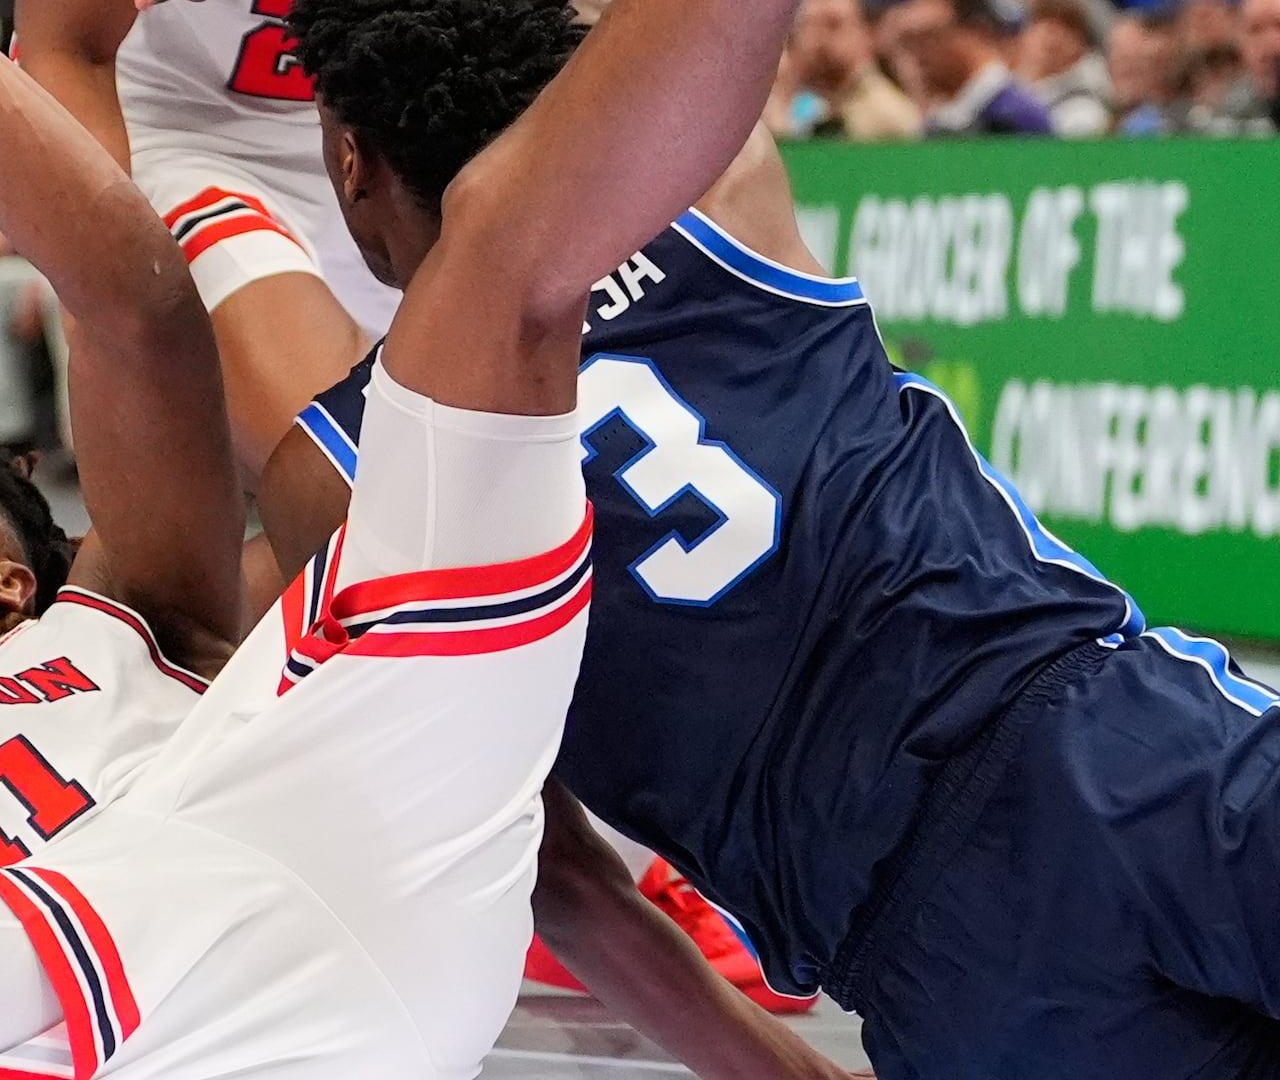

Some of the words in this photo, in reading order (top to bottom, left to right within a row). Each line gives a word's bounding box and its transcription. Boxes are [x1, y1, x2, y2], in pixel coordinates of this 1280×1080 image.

[849, 192, 1015, 324] GROCER
[1017, 184, 1086, 320] OF
[1089, 178, 1191, 322] THE
[577, 352, 783, 608] 3
